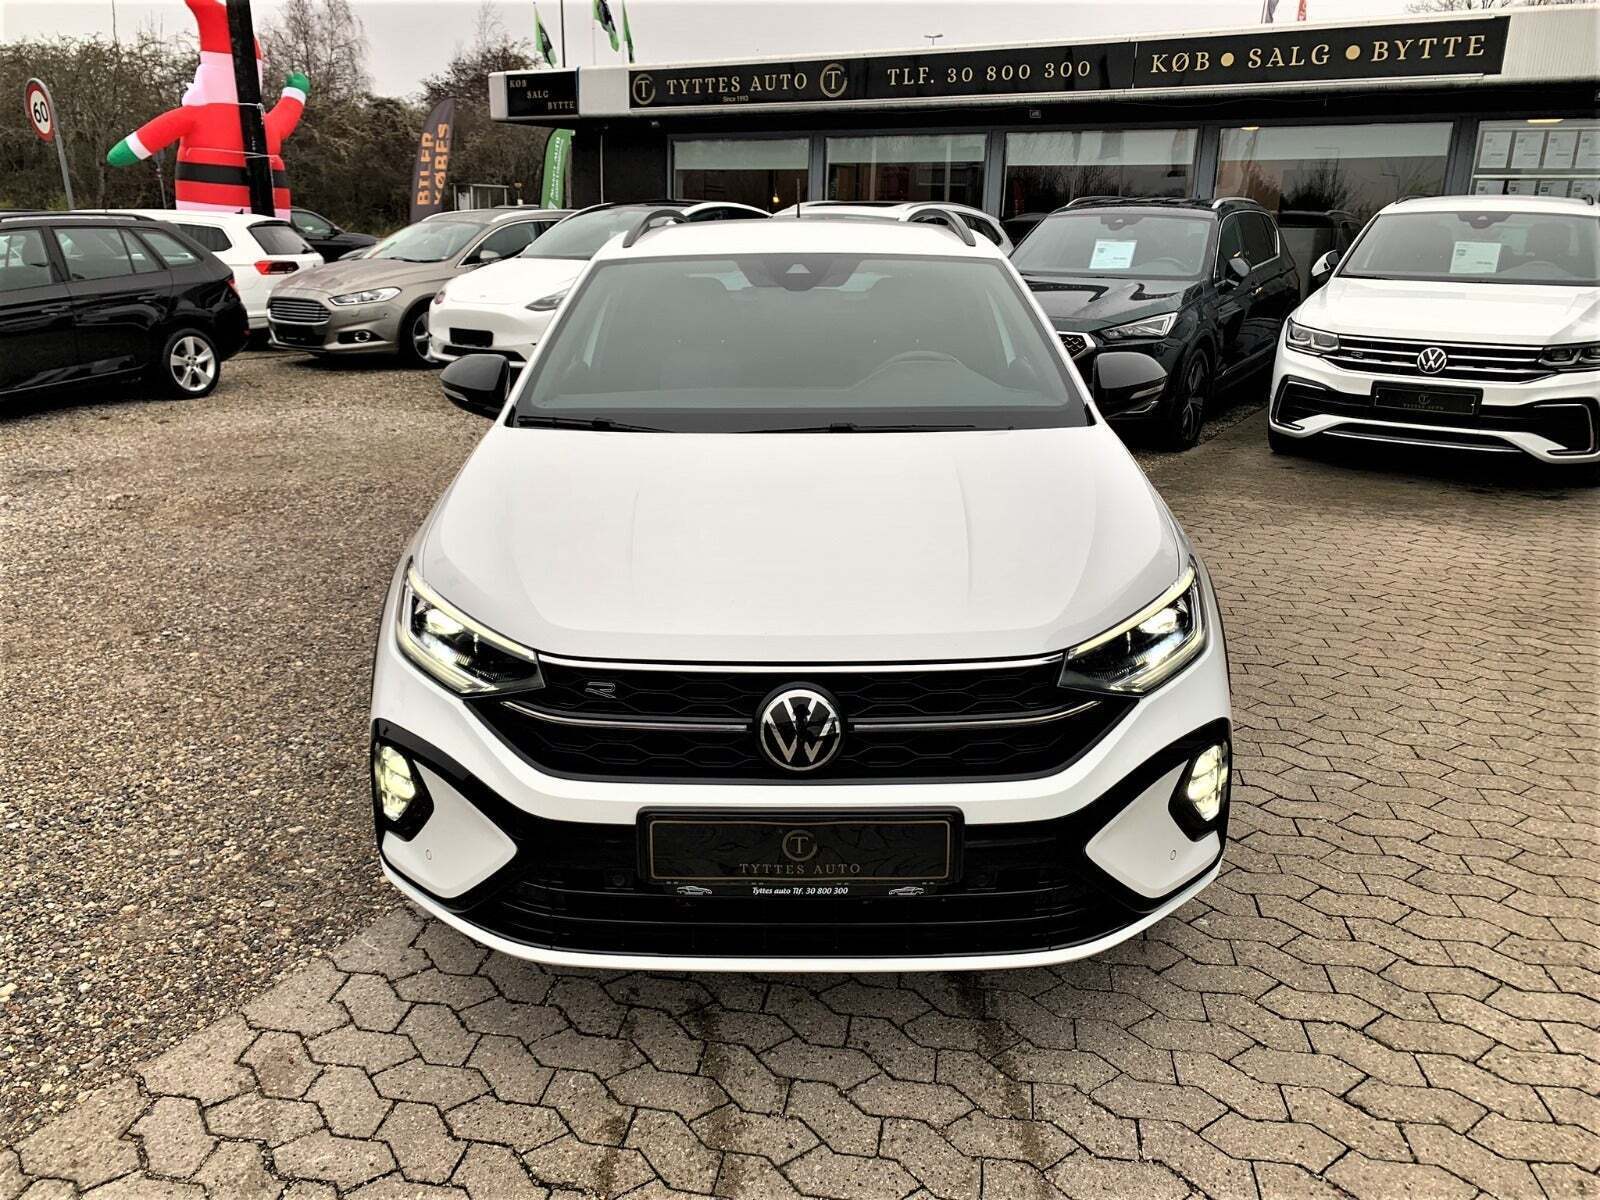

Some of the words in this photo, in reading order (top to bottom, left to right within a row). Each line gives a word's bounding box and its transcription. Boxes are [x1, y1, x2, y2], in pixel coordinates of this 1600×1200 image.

[1150, 51, 1210, 73] KØB
[1248, 44, 1331, 69] SALG
[1370, 34, 1486, 62] BYTTE
[666, 75, 741, 95] TYTTES
[749, 72, 807, 92] AUTO
[887, 66, 935, 86] TLF.
[947, 66, 973, 83] 30
[986, 64, 1031, 81] 800
[1044, 60, 1091, 79] 300
[33, 101, 48, 123] 60
[739, 863, 805, 874] TYTTES
[814, 863, 861, 873] AUTO
[752, 886, 773, 895] Tyttes
